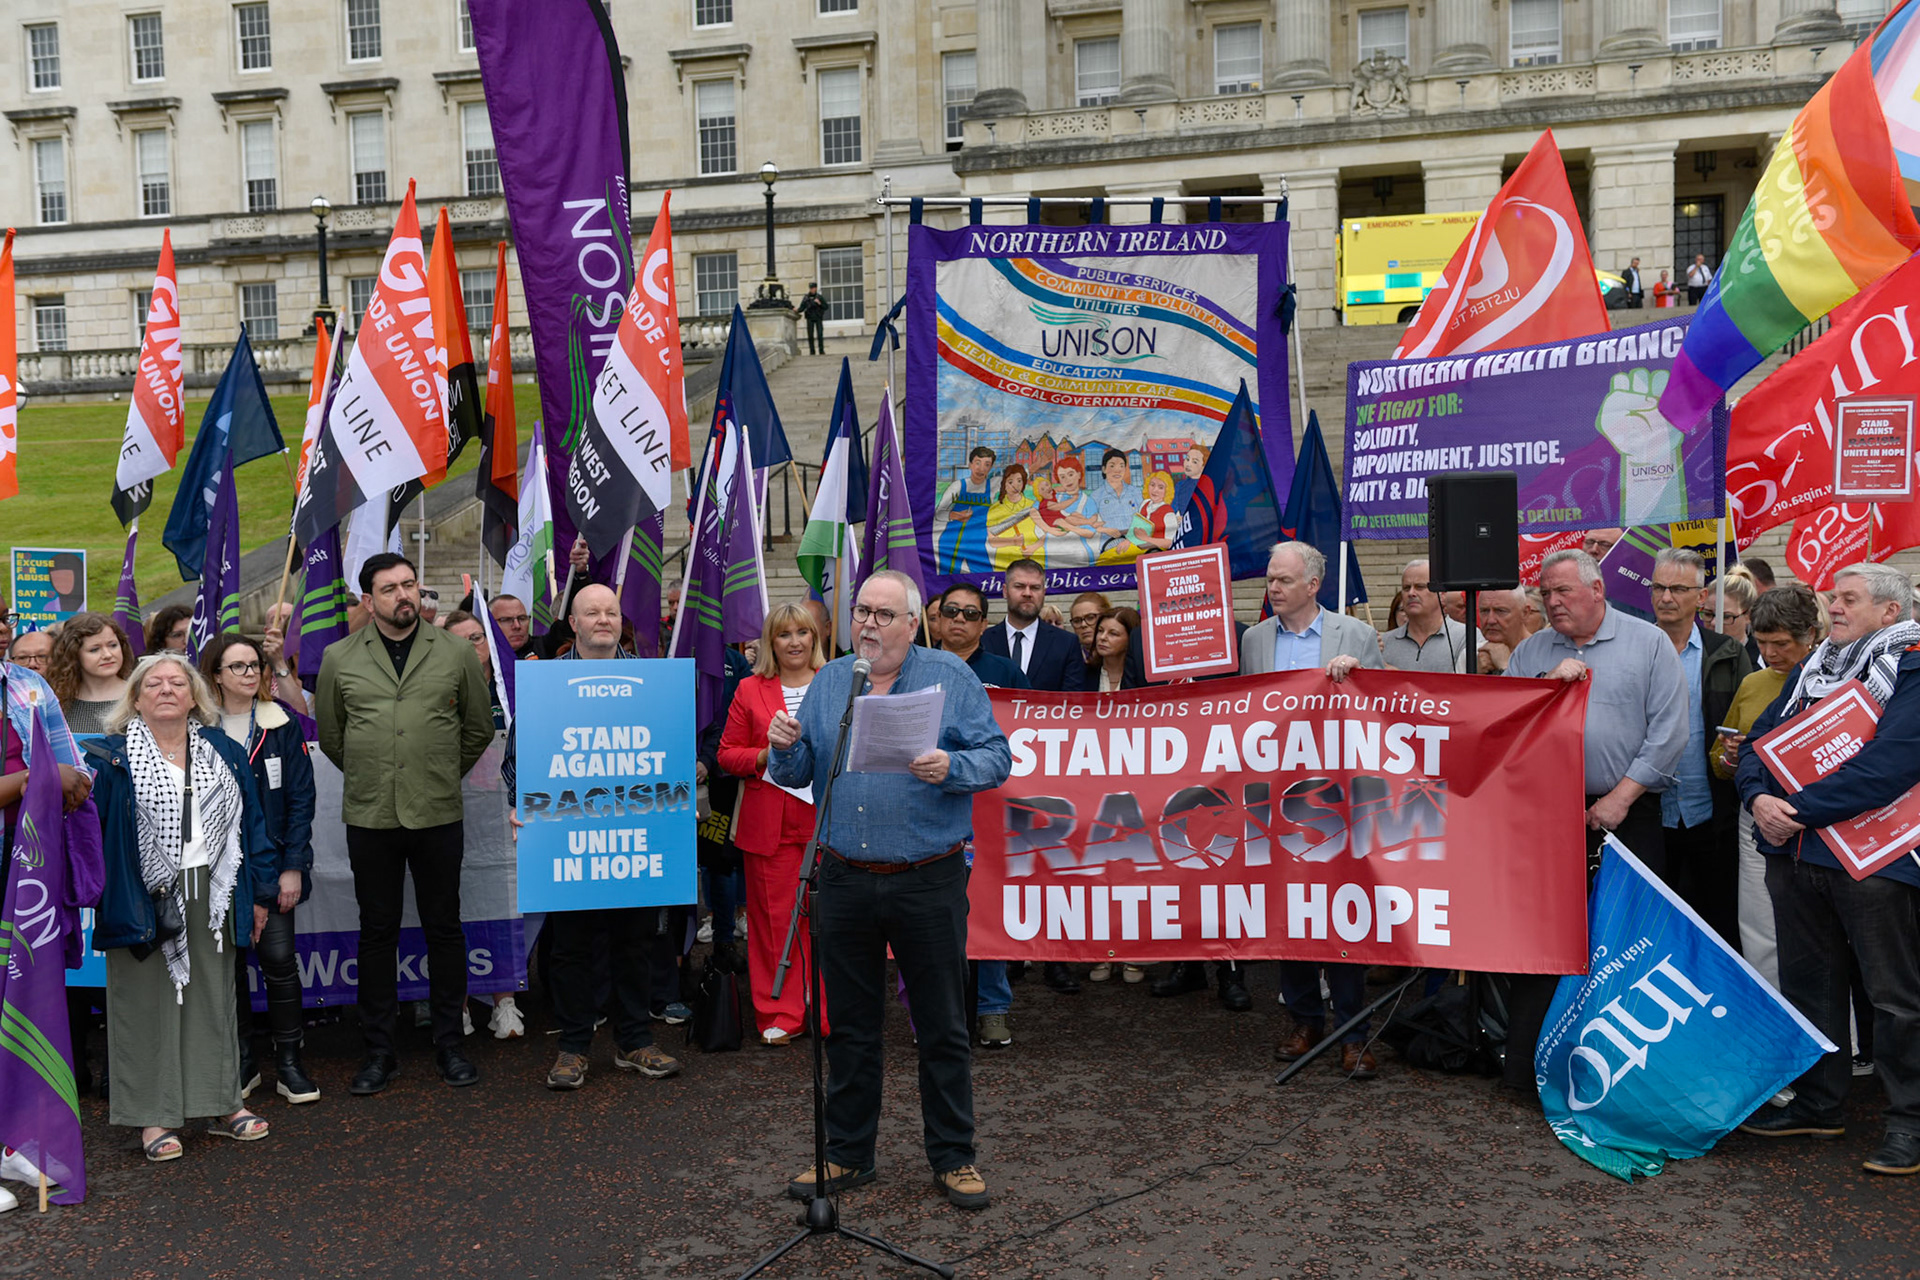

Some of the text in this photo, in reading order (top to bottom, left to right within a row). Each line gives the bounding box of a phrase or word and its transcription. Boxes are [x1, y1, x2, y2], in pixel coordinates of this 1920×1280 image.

[1367, 216, 1479, 230] EMERGENCY AMBULAN
[968, 229, 1227, 254] NORTHERN IRELAND
[1077, 267, 1201, 303] PUBLIC SERVICES
[1035, 272, 1234, 337] COMMUNITY & VOLUNTARY
[1073, 298, 1141, 316] UTILITIES
[369, 290, 440, 421] ADE UNION
[1041, 326, 1157, 358] UNISON
[956, 340, 1178, 397] HEALTH & COMMUNITY CARE
[1031, 358, 1124, 379] EDUCATION
[1356, 325, 1689, 397] NORTHERN HEALTH BRANC
[140, 356, 178, 427] UNION
[997, 378, 1161, 408] LOCAL GOVERNMENT
[1356, 392, 1464, 426] WE FIGHT FOR:
[342, 395, 392, 462] LINE
[1856, 427, 1894, 435] AGAINST
[1860, 419, 1889, 428] STAND
[619, 406, 671, 473] LINE
[1843, 449, 1869, 457] UNITE
[1881, 448, 1905, 457] HOPE
[580, 437, 611, 486] WEST
[1477, 440, 1566, 468] JUSTICE,
[1632, 464, 1674, 477] UNISON
[1389, 481, 1402, 500] &
[1527, 507, 1583, 524] DELIVER
[981, 576, 1003, 593] th
[1098, 573, 1138, 586] serv
[1168, 574, 1200, 587] STAND
[1617, 565, 1641, 581] BELFAST
[17, 589, 37, 597] SAY
[1158, 593, 1216, 614] RACISM
[1165, 582, 1206, 598] AGAINST
[18, 612, 57, 620] RACISM
[1154, 608, 1222, 626] UNITE IN HOPE
[578, 682, 633, 698] nicva
[1011, 690, 1452, 720] Trade Unions and Communities
[562, 725, 651, 752] STAND
[1791, 728, 1818, 747] CONGRESS
[1822, 713, 1840, 727] TRADE
[1008, 719, 1450, 777] STAND AGAINST
[1811, 731, 1852, 762] STAND
[1814, 736, 1865, 776] AGAINST
[548, 751, 667, 779] AGAINST
[521, 780, 691, 823] RACISM
[1003, 775, 1448, 878] RACISM
[568, 827, 648, 855] UNITE
[553, 853, 663, 882] IN HOPE
[1002, 882, 1451, 947] UNITE IN HOPE
[1620, 935, 1654, 962] Irish
[1578, 960, 1626, 1012] National
[1567, 953, 1728, 1112] into
